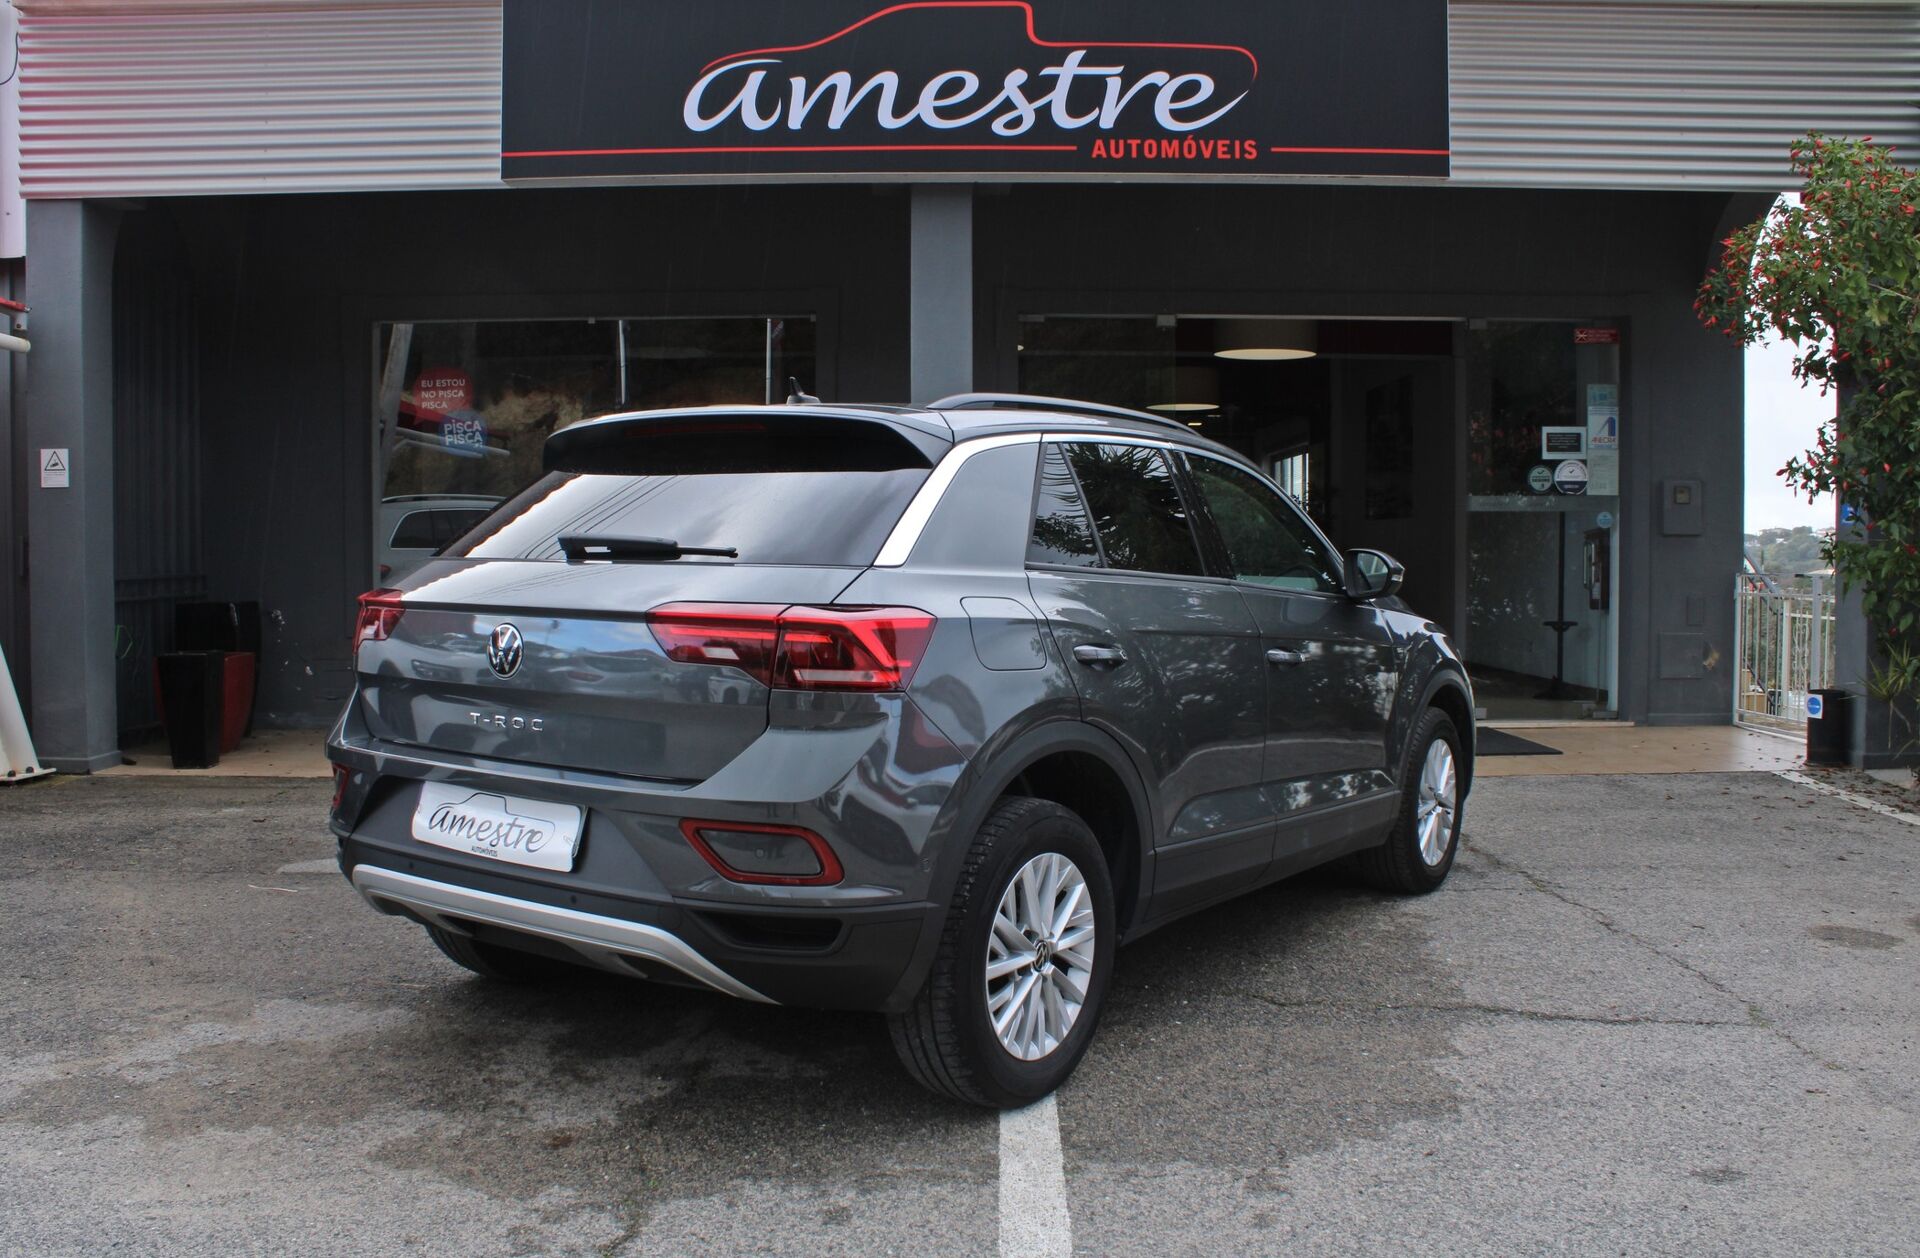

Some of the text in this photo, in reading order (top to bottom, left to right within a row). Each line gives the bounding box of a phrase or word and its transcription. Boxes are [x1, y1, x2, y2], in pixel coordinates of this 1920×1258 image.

[683, 50, 1250, 137] amestre
[1091, 135, 1258, 160] AUTOMÓVEIS
[439, 390, 464, 398] PISCA
[445, 432, 483, 445] PISCA
[470, 712, 543, 731] T-ROC
[429, 805, 552, 852] amestre
